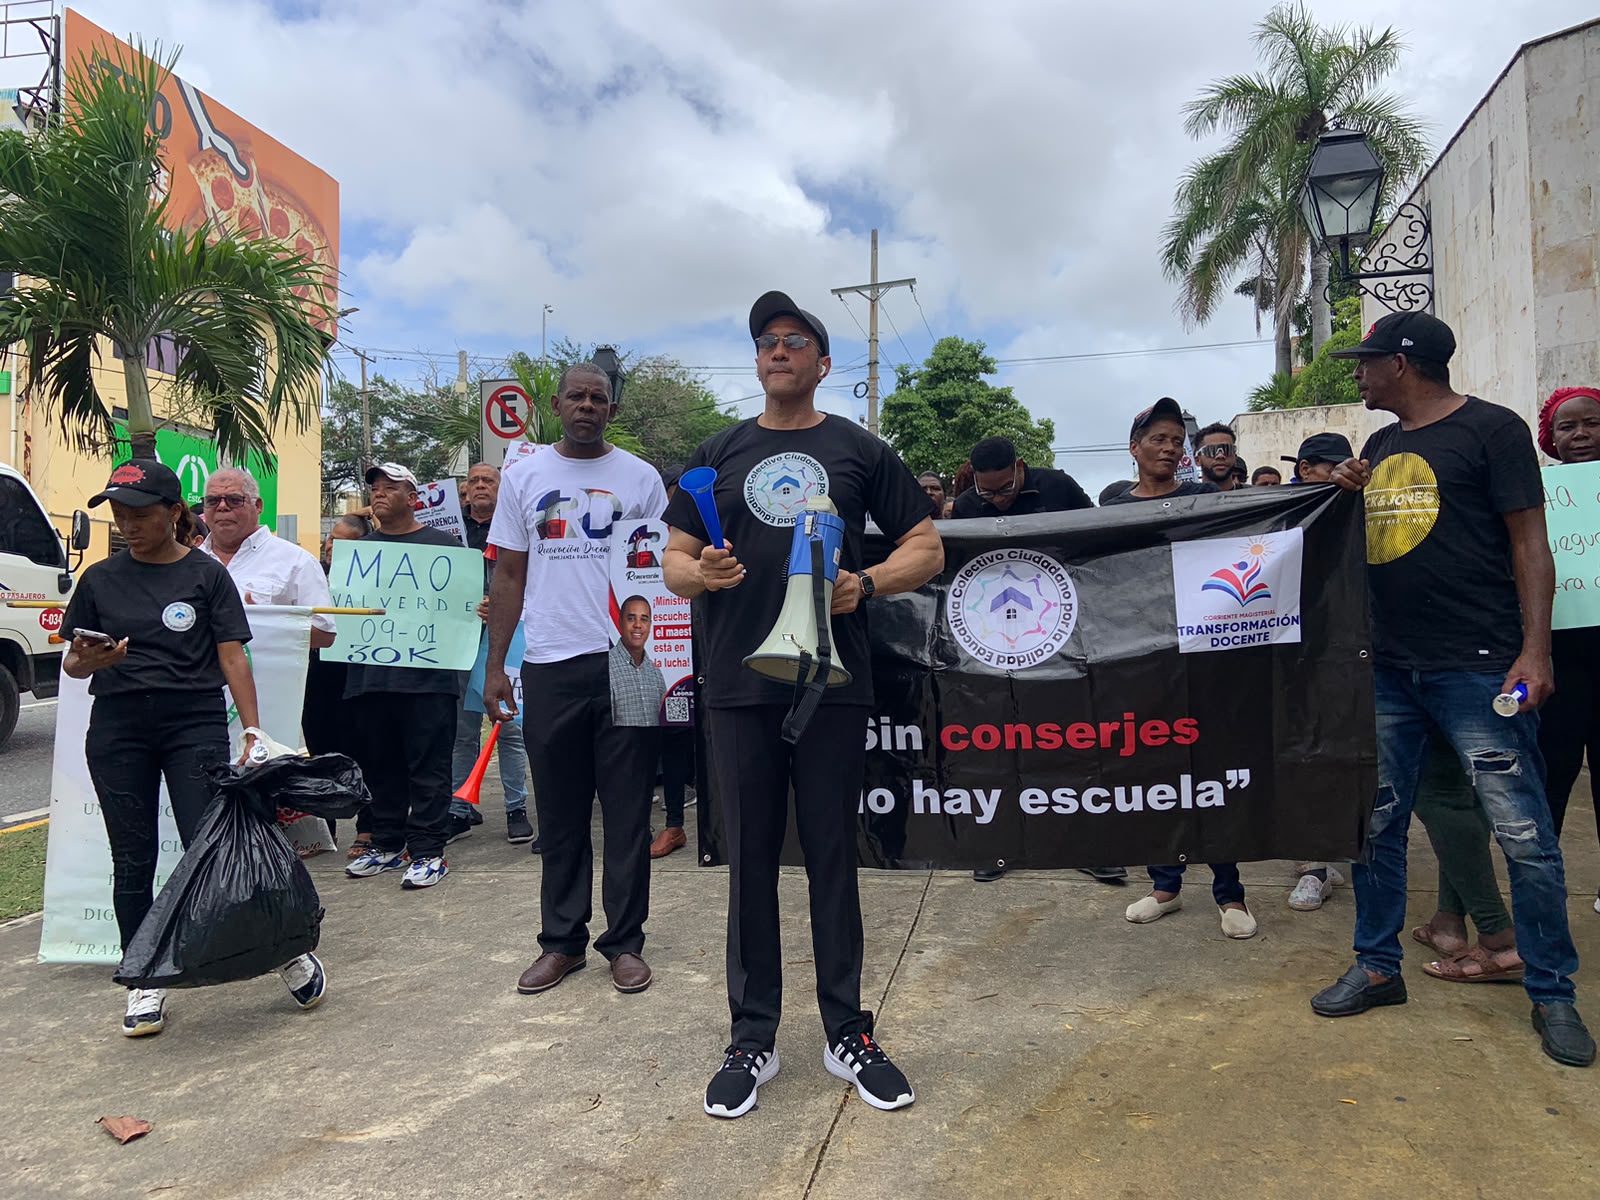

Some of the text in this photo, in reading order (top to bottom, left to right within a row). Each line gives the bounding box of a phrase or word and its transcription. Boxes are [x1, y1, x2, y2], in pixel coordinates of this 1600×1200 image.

[500, 394, 518, 428] E
[747, 455, 783, 485] Colectivo
[784, 453, 825, 482] Ciudadano
[746, 485, 776, 524] Educativa
[346, 548, 452, 592] MAO
[7, 592, 46, 600] PASAJEROS
[653, 612, 691, 622] escuche:
[950, 550, 1074, 667] Colectivo Ciudadano por la Calidad Educativa
[1203, 609, 1277, 621] CORRIENTE MAGISTERIAL
[655, 627, 692, 637] el maest
[1177, 613, 1300, 636] TRANSFORMACIÓN
[653, 642, 685, 652] está en
[1210, 632, 1270, 647] DOCENTE
[347, 644, 439, 664] 30K
[654, 657, 690, 668] la lucha!
[940, 712, 1200, 757] conserjes
[912, 779, 1002, 824] hay
[84, 908, 115, 922] DIG
